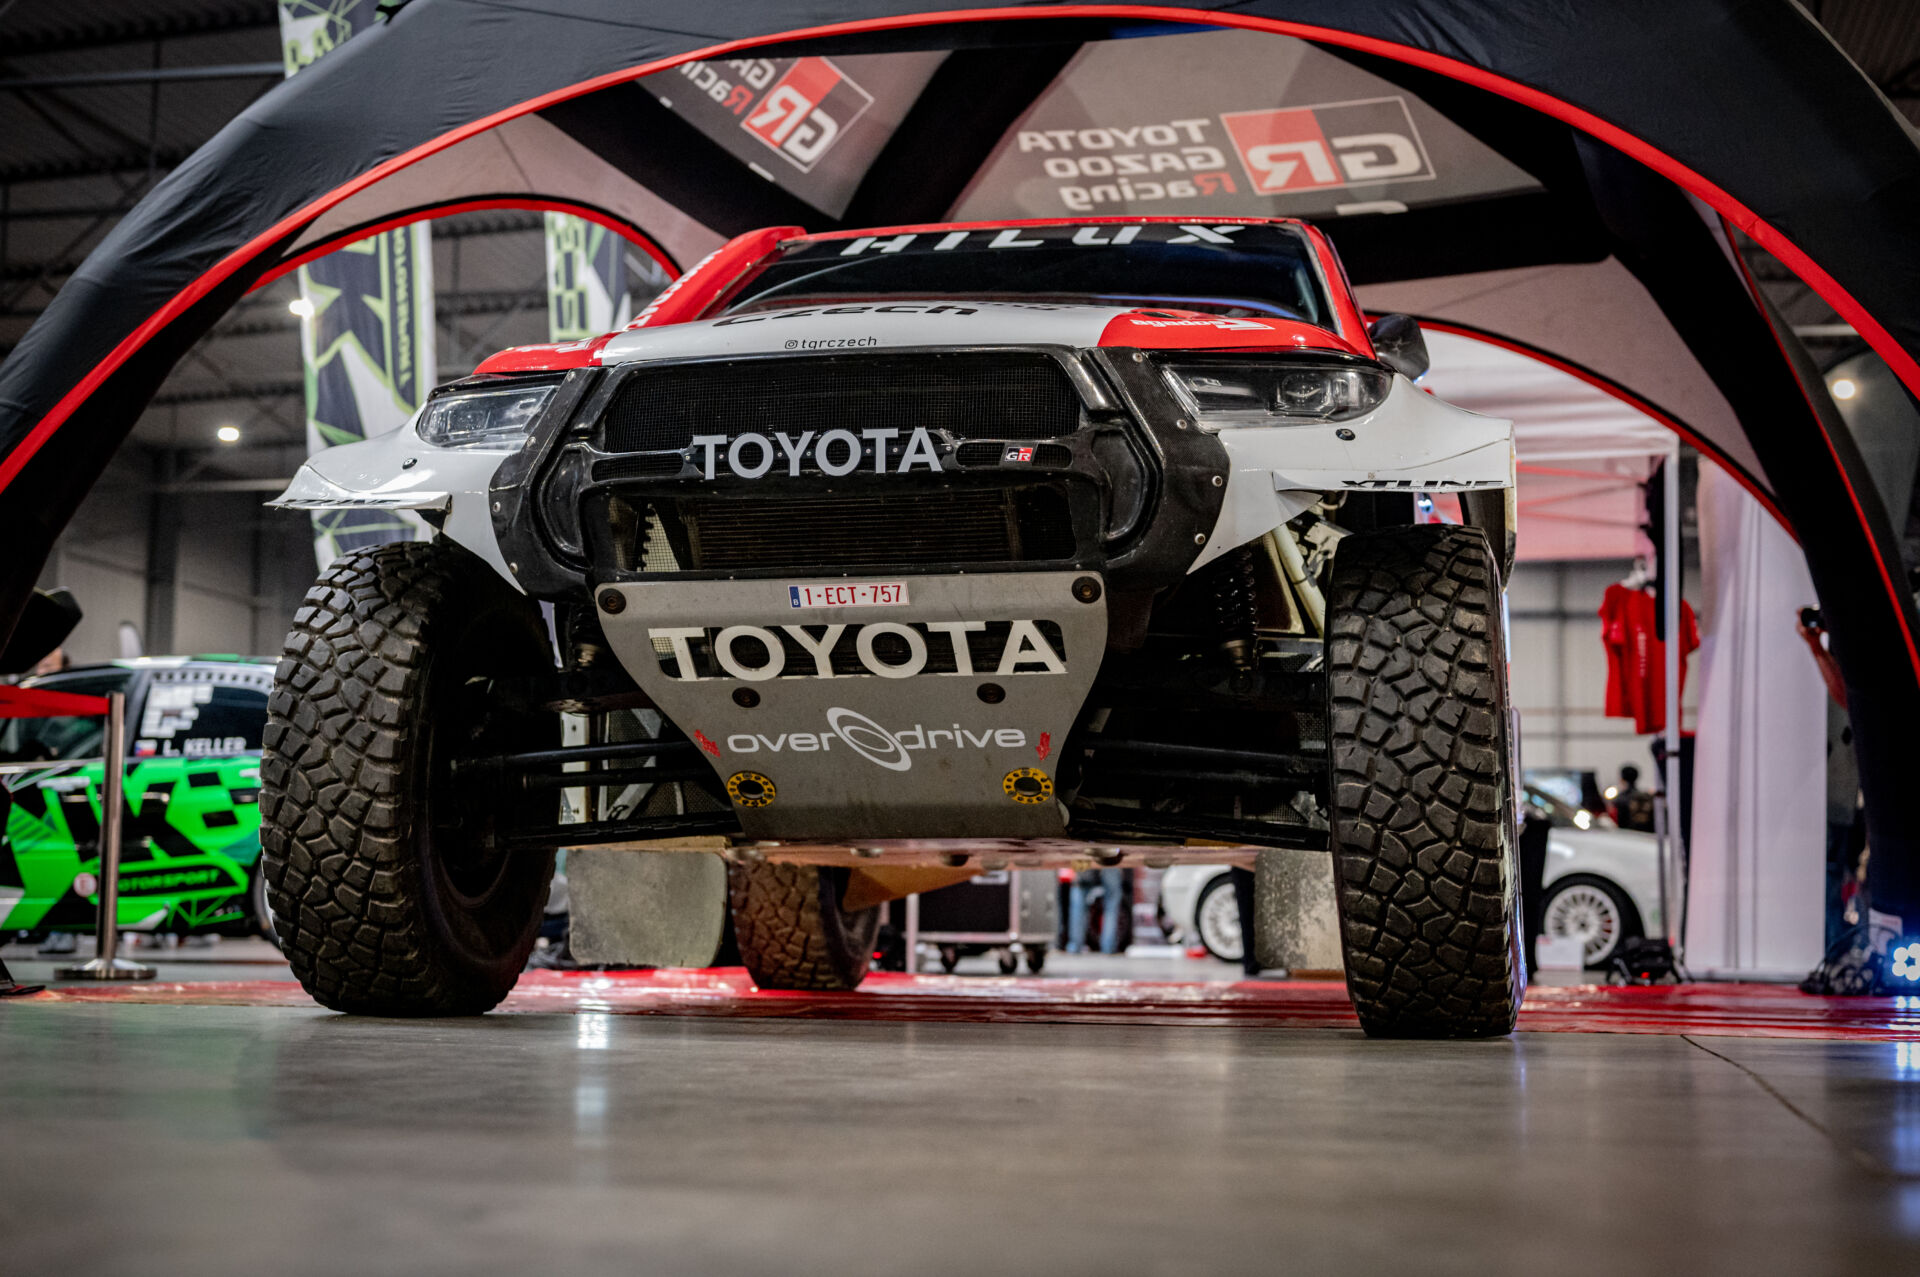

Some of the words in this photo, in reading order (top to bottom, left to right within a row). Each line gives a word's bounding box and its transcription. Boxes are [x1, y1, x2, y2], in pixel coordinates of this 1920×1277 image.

[840, 225, 1245, 256] HILUX
[711, 305, 979, 327] czech
[692, 426, 943, 480] TOYOTA
[1005, 446, 1033, 462] GR
[804, 584, 901, 606] 1-ECT-757
[648, 619, 1068, 682] TOYOTA
[183, 737, 247, 757] KELLER
[116, 868, 220, 892] OTORSPORT
